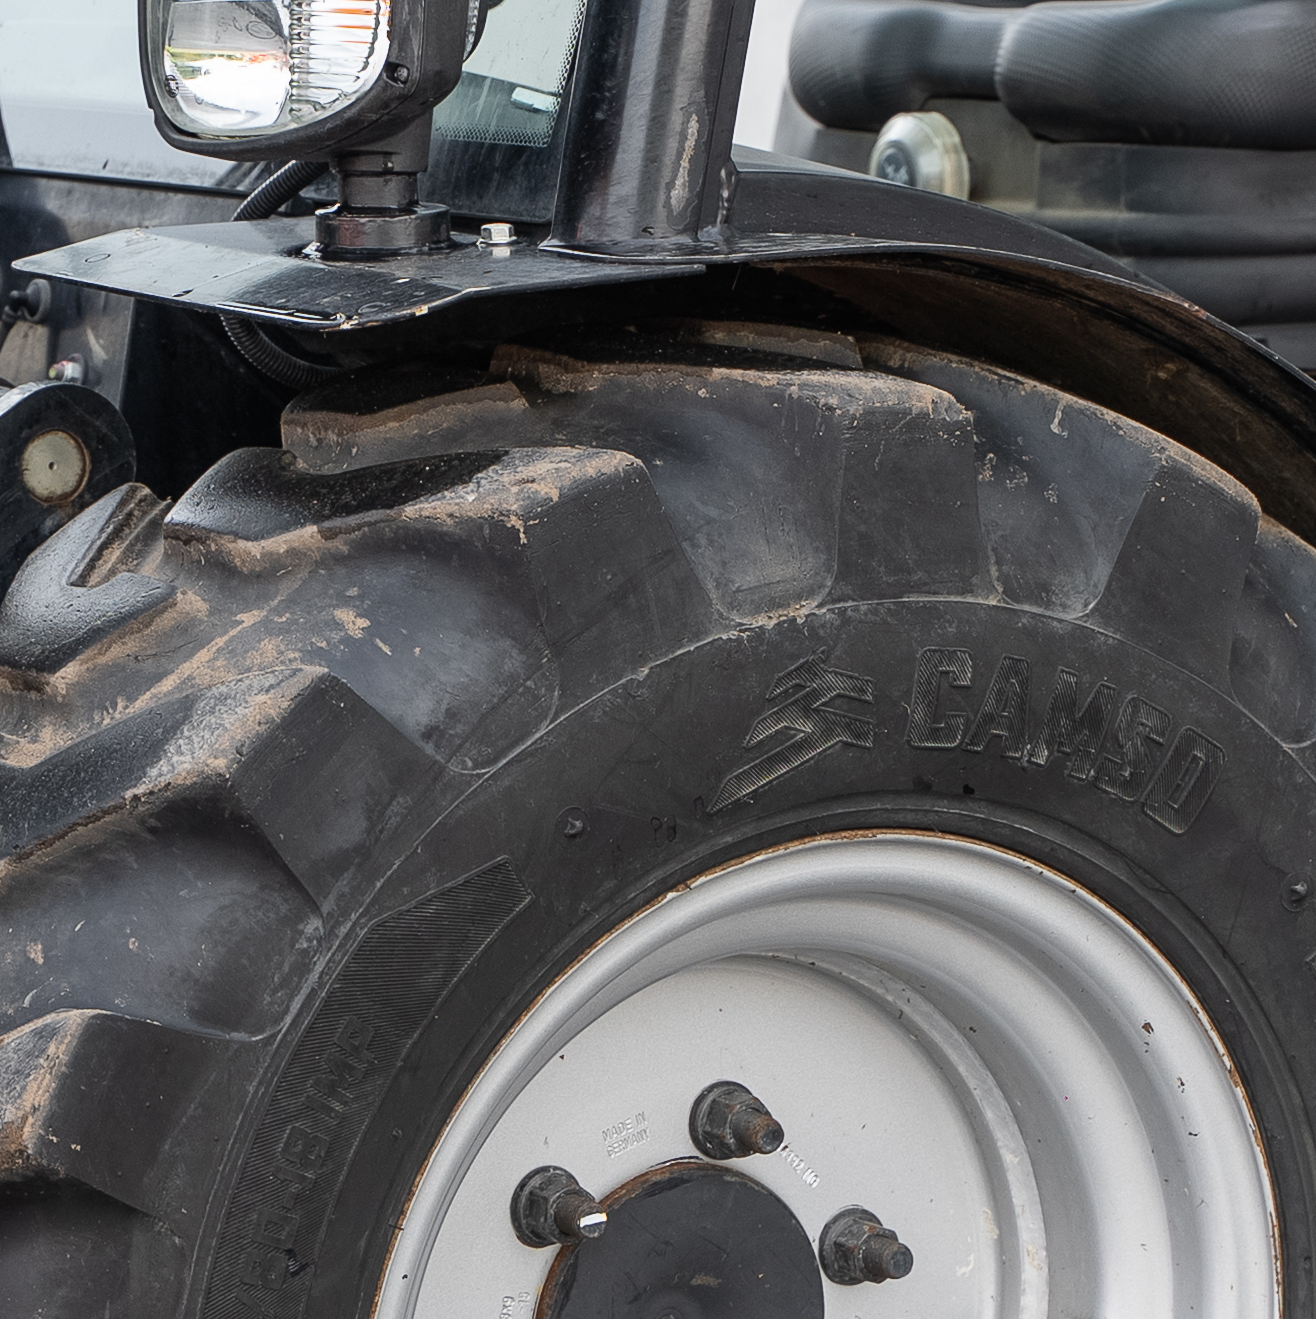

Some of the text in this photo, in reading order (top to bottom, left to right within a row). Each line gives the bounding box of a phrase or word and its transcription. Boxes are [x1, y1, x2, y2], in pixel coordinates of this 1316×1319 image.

[904, 646, 1228, 836] CAMSO
[599, 1110, 649, 1144] MADE IN
